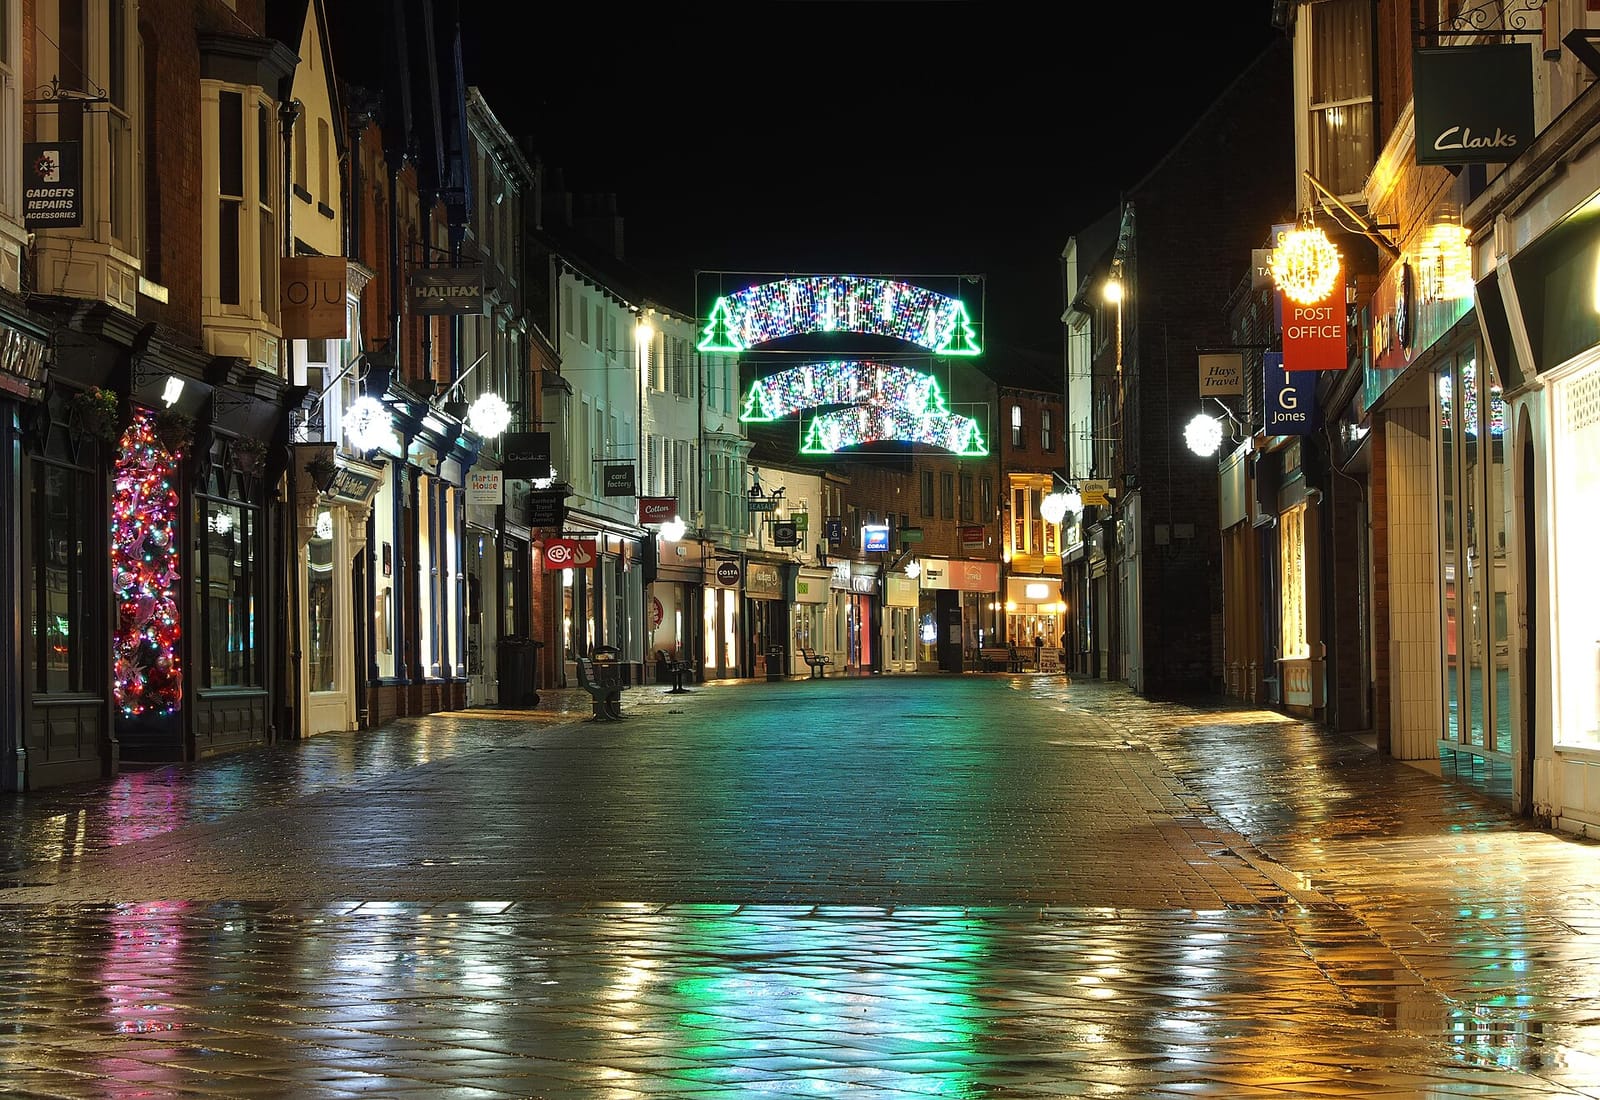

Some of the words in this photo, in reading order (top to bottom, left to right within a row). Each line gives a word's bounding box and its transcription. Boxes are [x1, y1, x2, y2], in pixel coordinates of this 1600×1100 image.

[1434, 126, 1517, 150] Clarks
[26, 188, 75, 198] GADGETS
[27, 200, 73, 210] REPAIRS
[26, 211, 76, 220] ACCESSORIES
[280, 281, 342, 310] OJU
[415, 286, 479, 298] HALIFAX
[1294, 307, 1333, 321] POST
[1287, 325, 1341, 339] OFFICE
[1209, 366, 1238, 378] Hays
[1204, 376, 1239, 387] Travel
[1279, 387, 1297, 409] G
[1271, 411, 1306, 424] Jones
[611, 472, 627, 480] card
[472, 482, 497, 490] House
[607, 479, 632, 489] factory
[645, 505, 669, 513] Cotton
